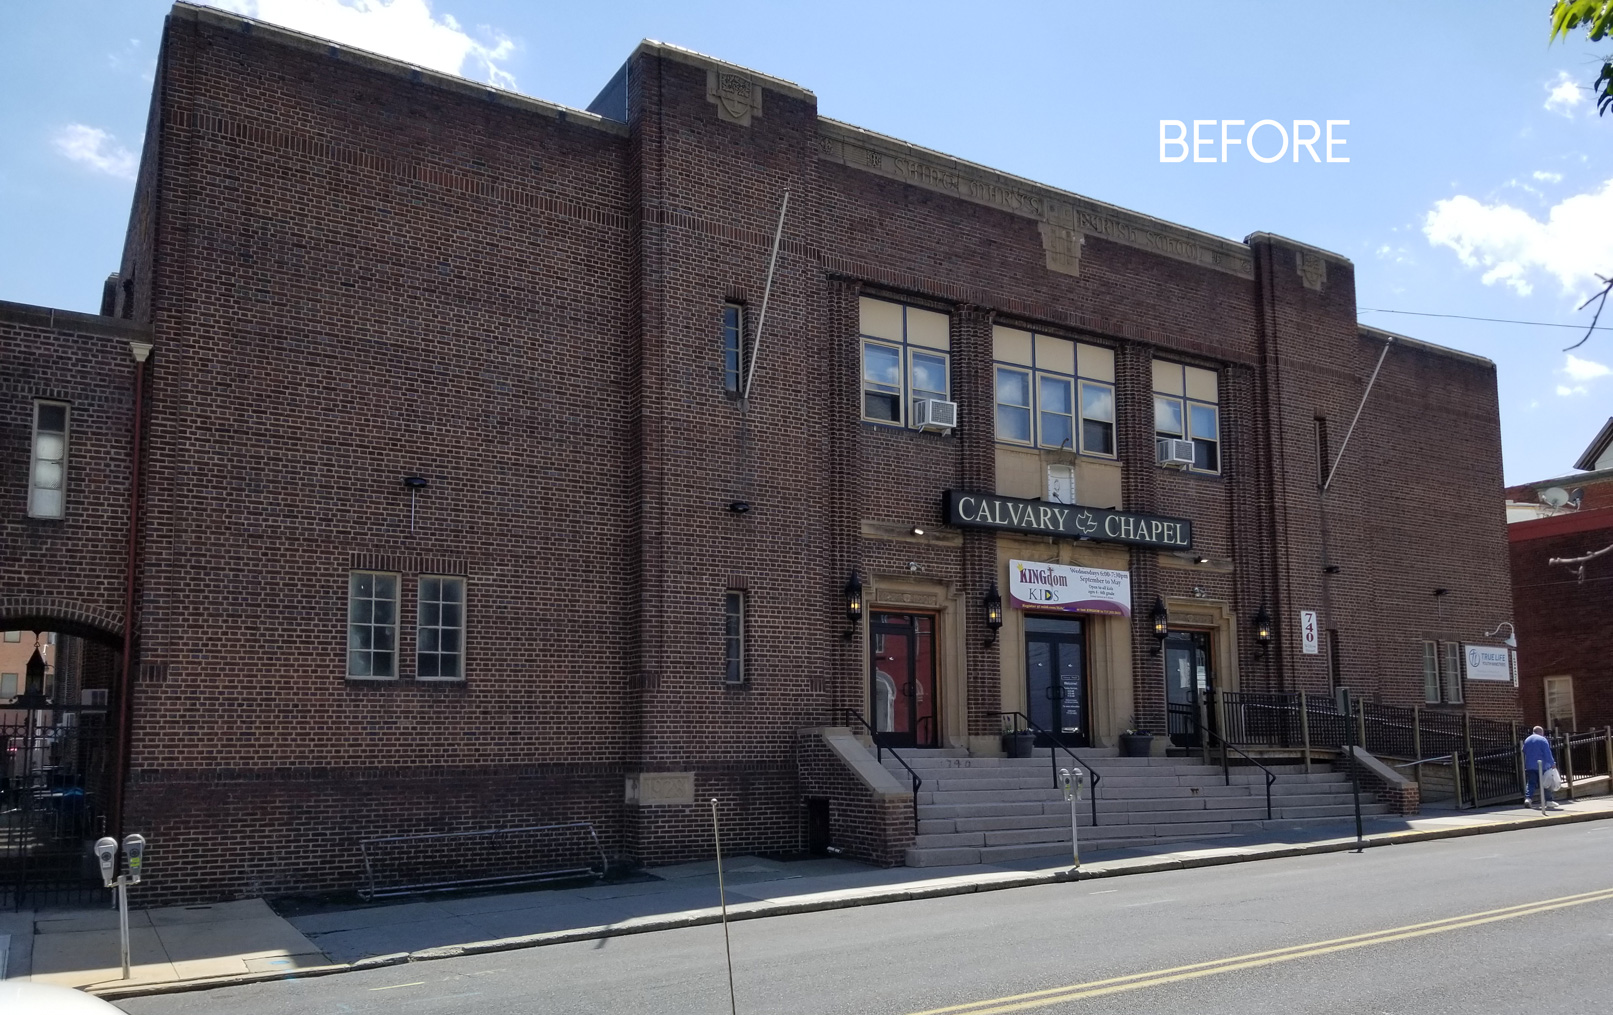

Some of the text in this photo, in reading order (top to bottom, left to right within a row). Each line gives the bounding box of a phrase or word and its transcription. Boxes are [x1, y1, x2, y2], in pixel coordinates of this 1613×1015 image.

[958, 496, 1188, 545] CALVARY CHAPEL
[1069, 567, 1099, 577] Wednesdays
[1079, 575, 1104, 584] September
[1111, 579, 1121, 587] May
[1029, 588, 1059, 602] KIDS
[1304, 613, 1314, 642] 740
[1481, 653, 1494, 661] TRUE
